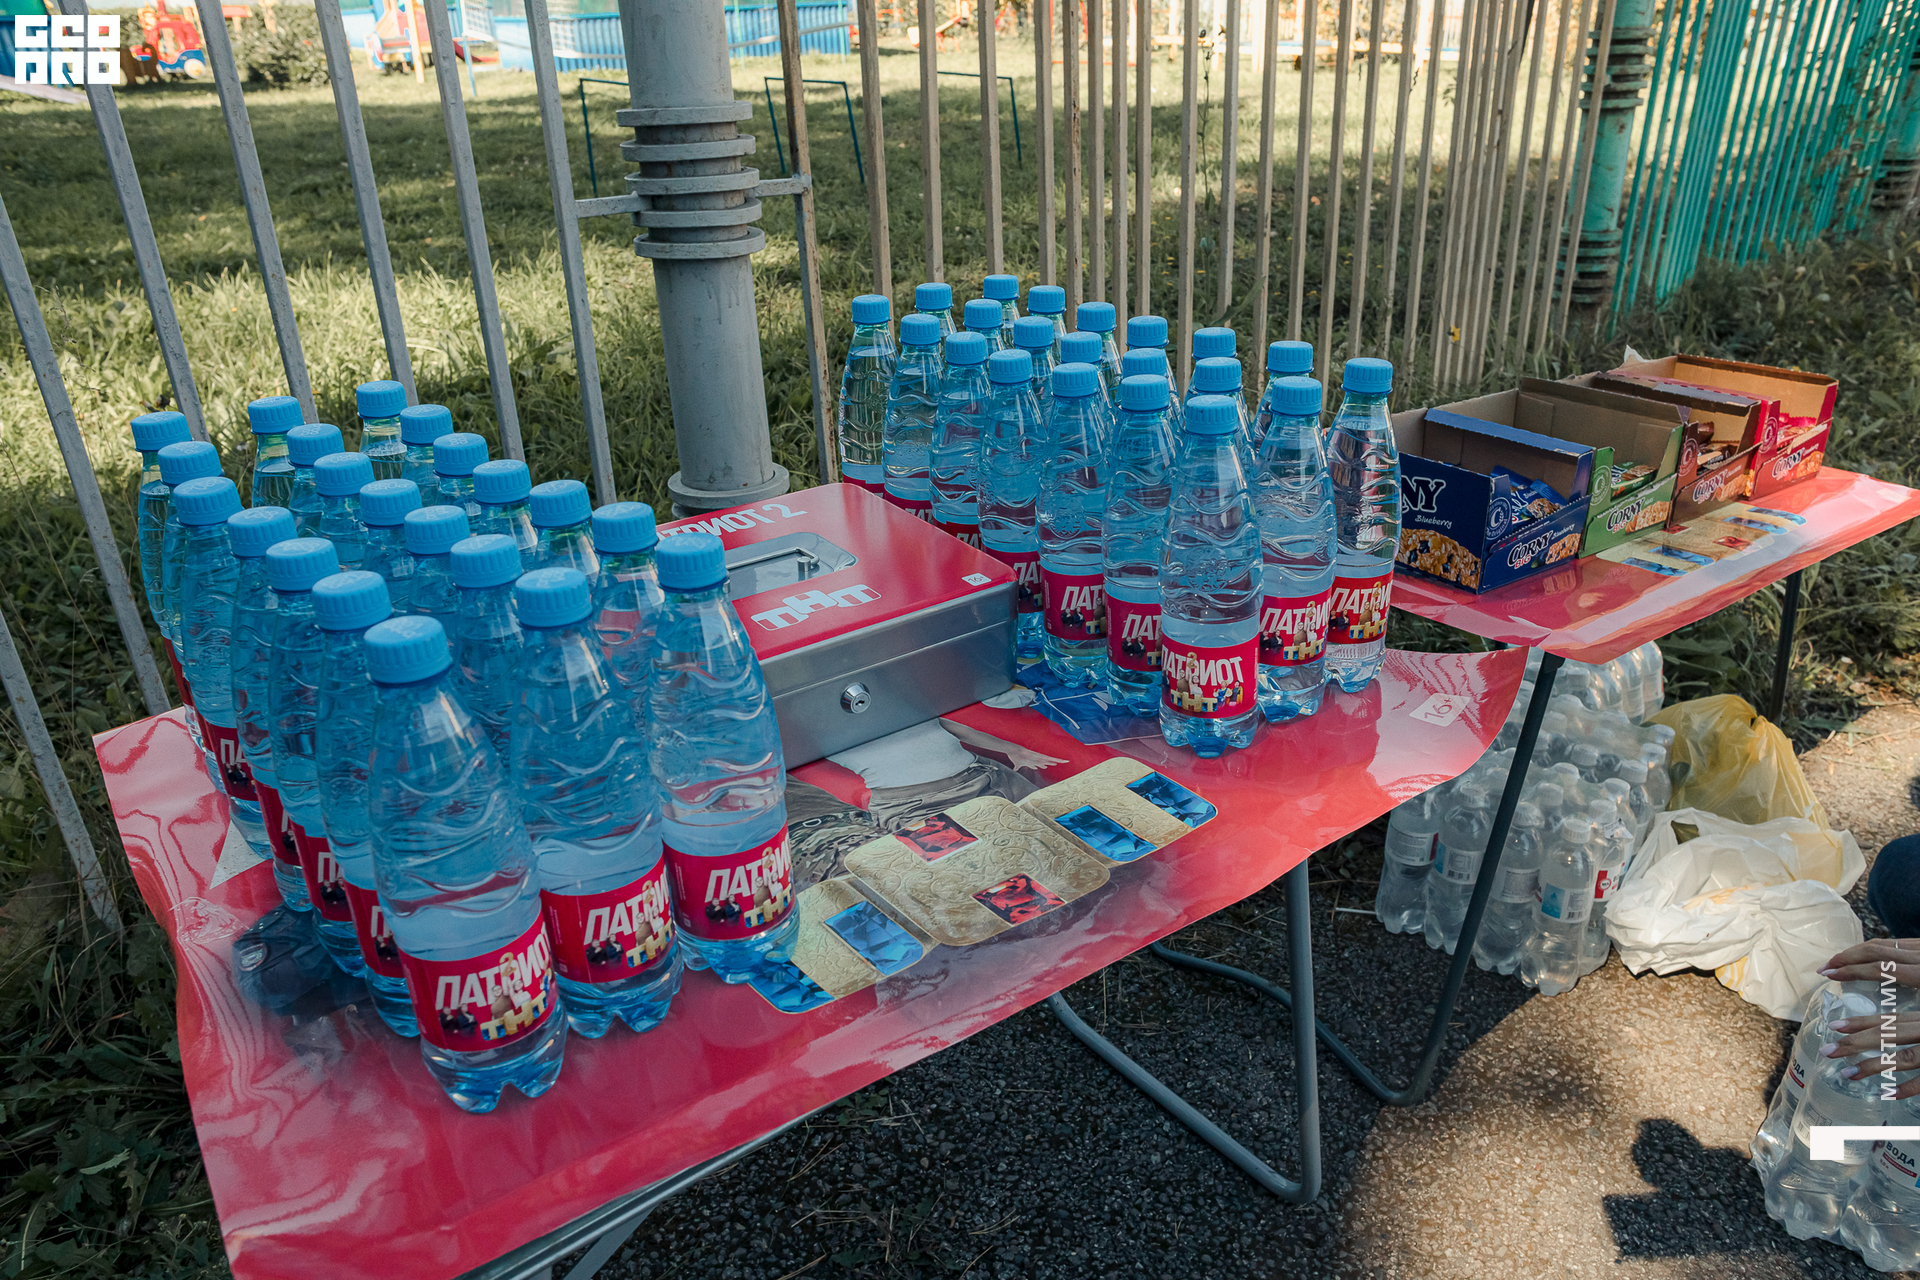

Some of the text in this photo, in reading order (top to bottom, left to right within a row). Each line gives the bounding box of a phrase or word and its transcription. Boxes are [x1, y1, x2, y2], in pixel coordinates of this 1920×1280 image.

[1692, 469, 1728, 502] CORNY
[762, 503, 808, 518] 2
[1414, 514, 1453, 530] Blueberry
[1606, 497, 1645, 531] CORNY
[1507, 530, 1554, 567] CORNY
[1514, 555, 1531, 569] BIG
[751, 584, 881, 632] ТНТ
[1284, 637, 1325, 660] ТНТ
[1170, 689, 1218, 713] ТНТ
[1425, 698, 1452, 719] 16+
[744, 884, 792, 928] ТНТ
[480, 990, 549, 1041] ТНТ
[1886, 1140, 1916, 1168] ВОДА
